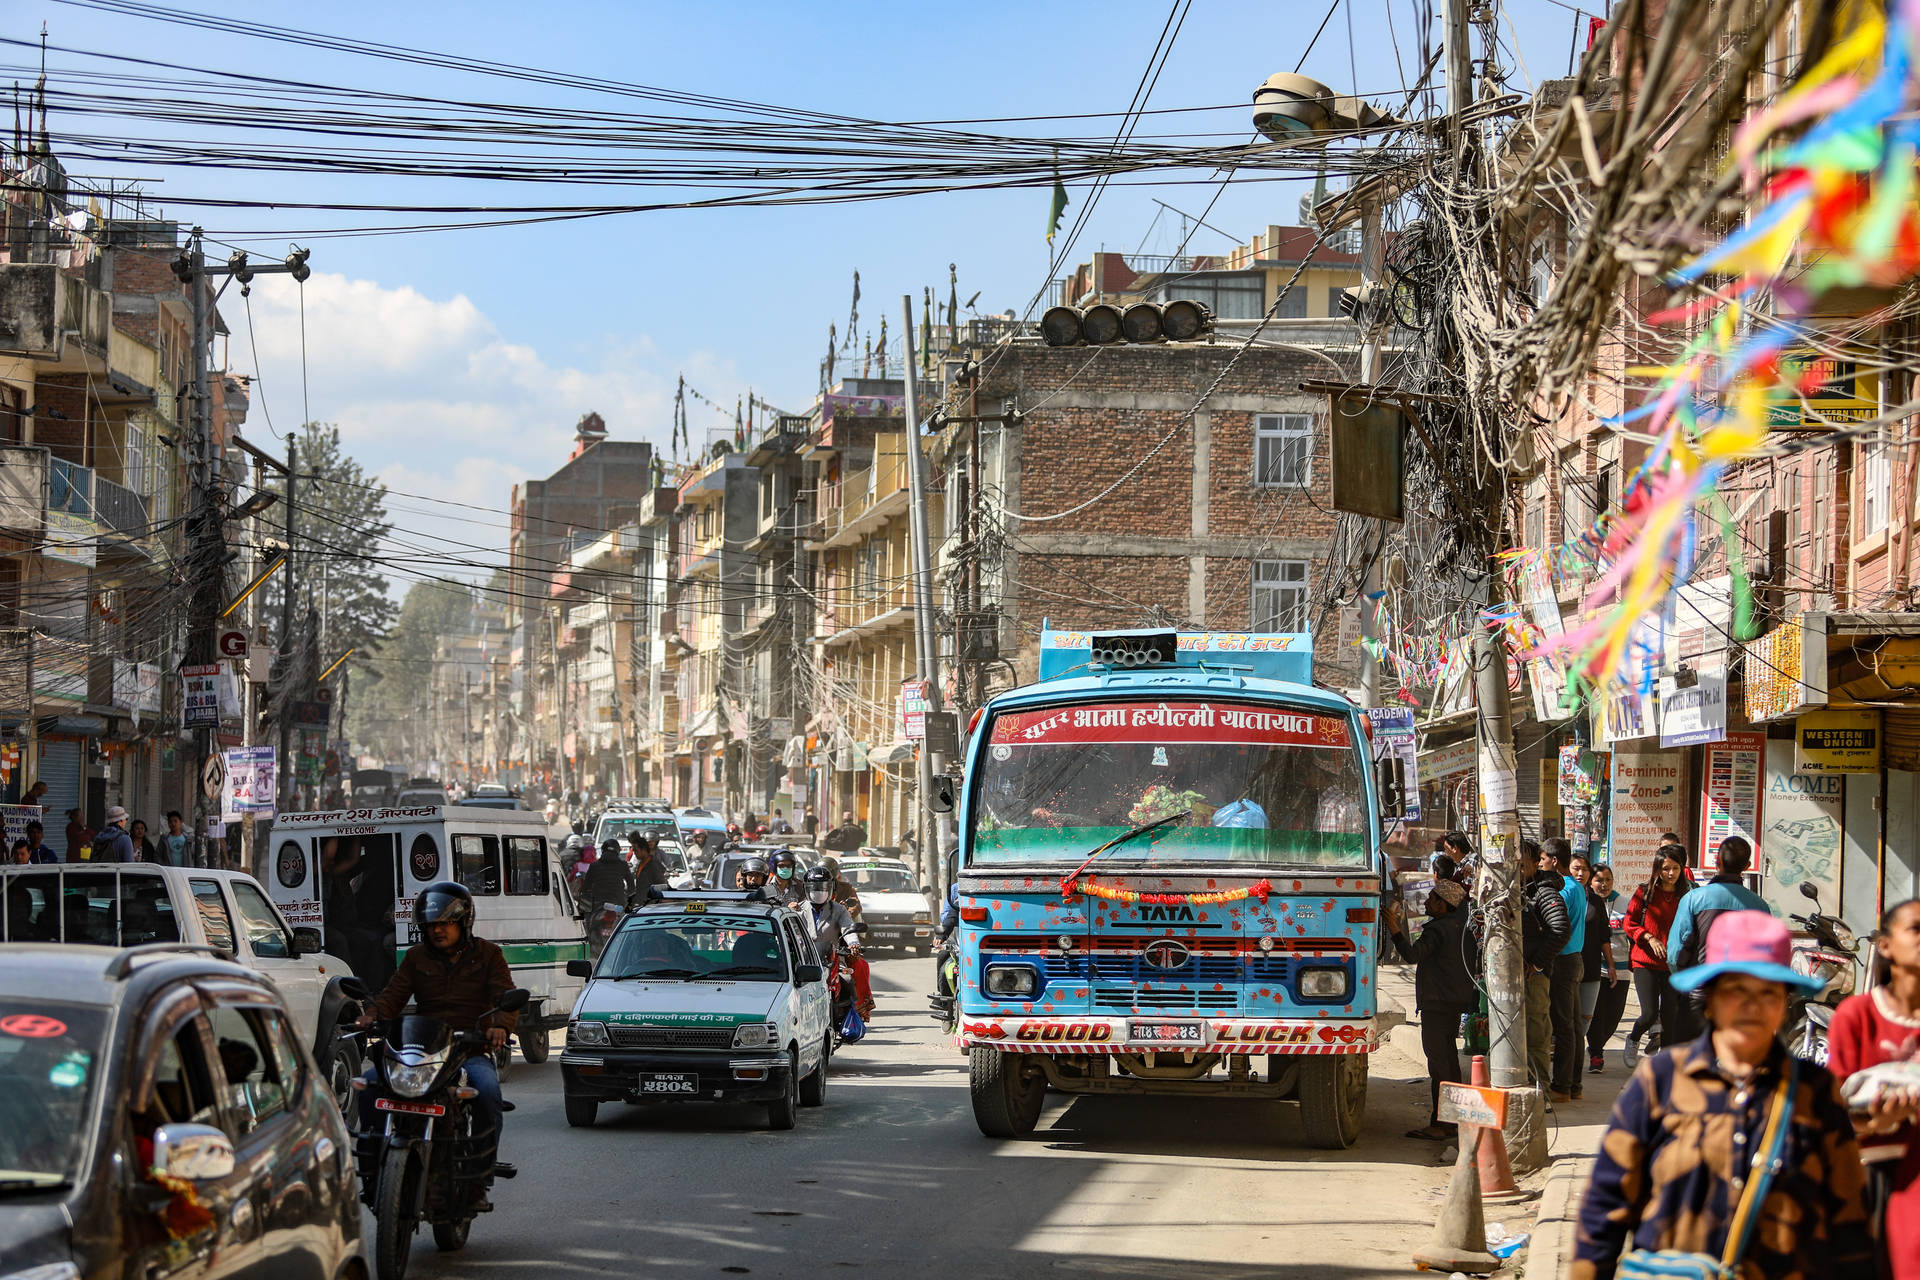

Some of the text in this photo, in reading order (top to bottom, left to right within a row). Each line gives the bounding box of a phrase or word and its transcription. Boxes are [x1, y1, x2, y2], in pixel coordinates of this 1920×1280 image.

[220, 631, 247, 657] G
[1073, 708, 1127, 728] आमा
[1219, 709, 1314, 735] यातायात
[1806, 731, 1863, 739] WESTERN
[1823, 739, 1862, 747] UNION
[1617, 763, 1677, 778] Feminine
[1630, 783, 1661, 798] Zone
[1770, 775, 1840, 794] ACME
[1769, 793, 1840, 804] Money Exchange
[336, 826, 376, 835] WELCOME
[1138, 906, 1194, 921] TATA
[629, 917, 766, 928] SPORTS
[1016, 1023, 1113, 1043] GOOD
[1216, 1024, 1316, 1044] LUCK
